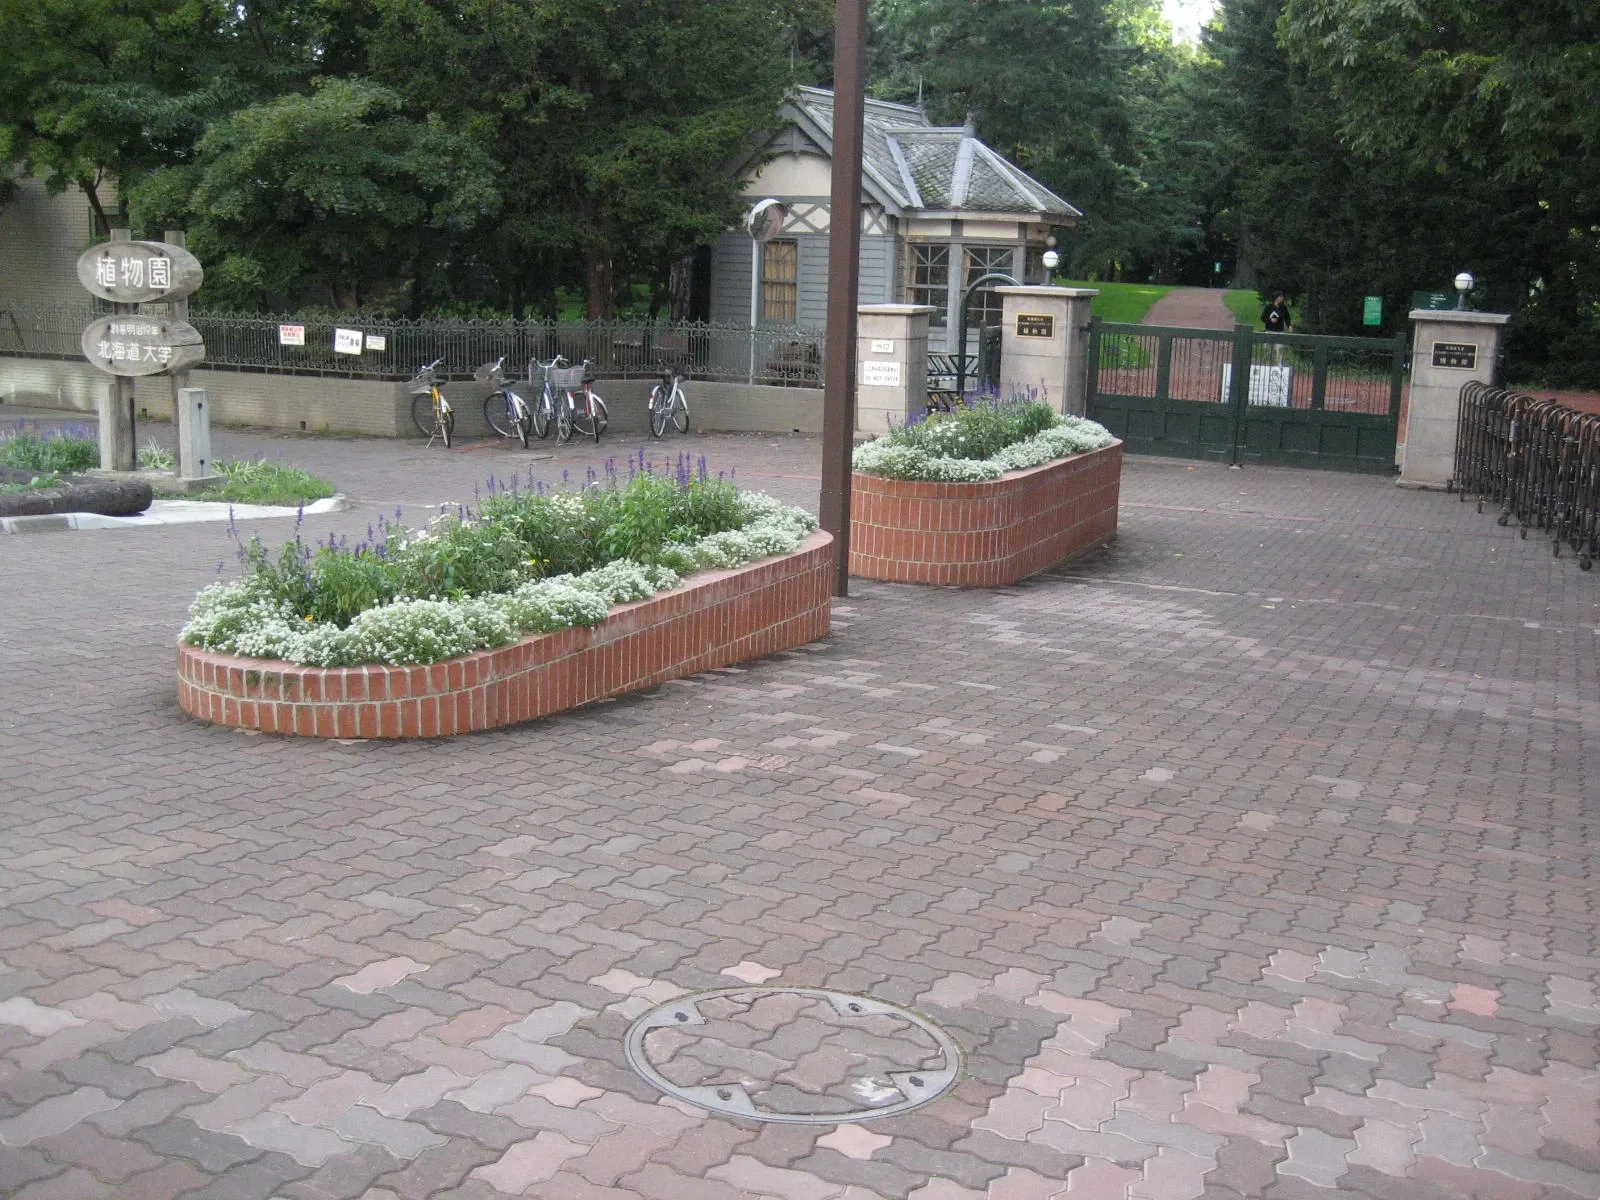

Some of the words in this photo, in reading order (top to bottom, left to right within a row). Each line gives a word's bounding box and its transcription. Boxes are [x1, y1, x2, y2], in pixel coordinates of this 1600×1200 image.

[95, 257, 171, 289] 植物園
[98, 340, 172, 363] 北海道大学
